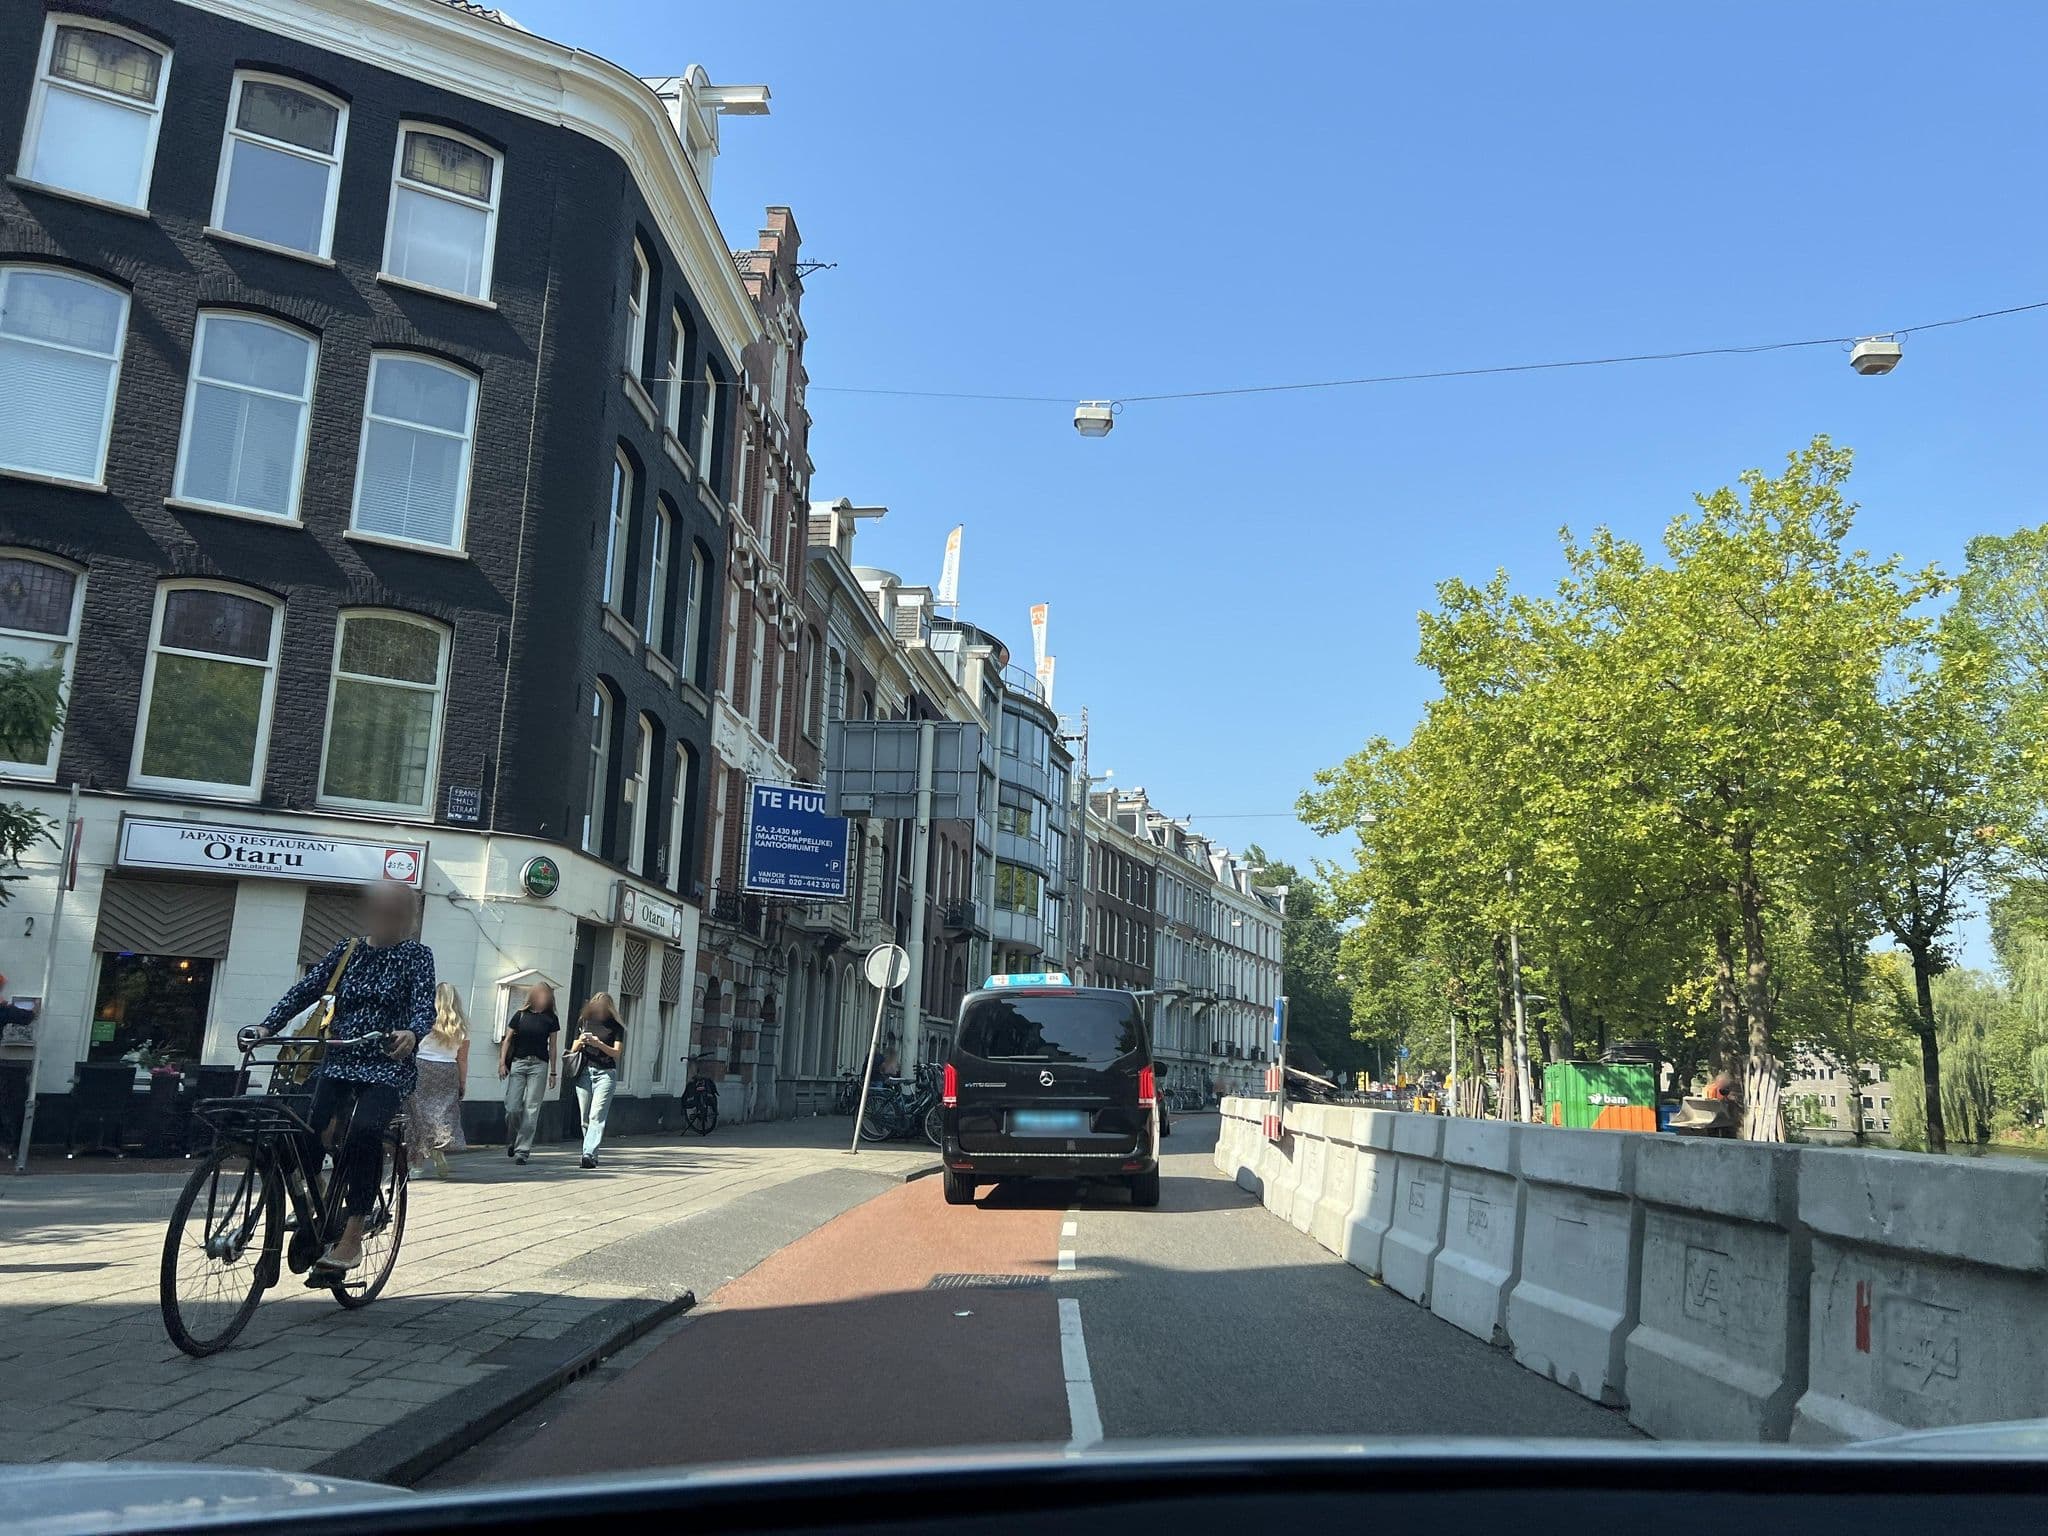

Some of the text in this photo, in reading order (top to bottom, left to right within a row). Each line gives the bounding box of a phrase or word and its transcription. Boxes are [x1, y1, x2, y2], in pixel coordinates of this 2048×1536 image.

[758, 790, 826, 814] TE HUU
[452, 805, 478, 814] STRAAT
[755, 825, 769, 833] CA.
[770, 827, 790, 836] 2.430
[179, 830, 338, 852] JAPANS RESTAURANT
[755, 832, 833, 848] (MAATSCHAPPELIJKE)
[755, 840, 820, 853] KANTOORRUIMTE
[203, 842, 304, 867] Otaru
[227, 862, 282, 871] www.otaru.nl
[387, 861, 414, 872] おたる
[642, 905, 666, 928] Otaru
[24, 916, 34, 937] 2
[1603, 1093, 1629, 1104] bam
